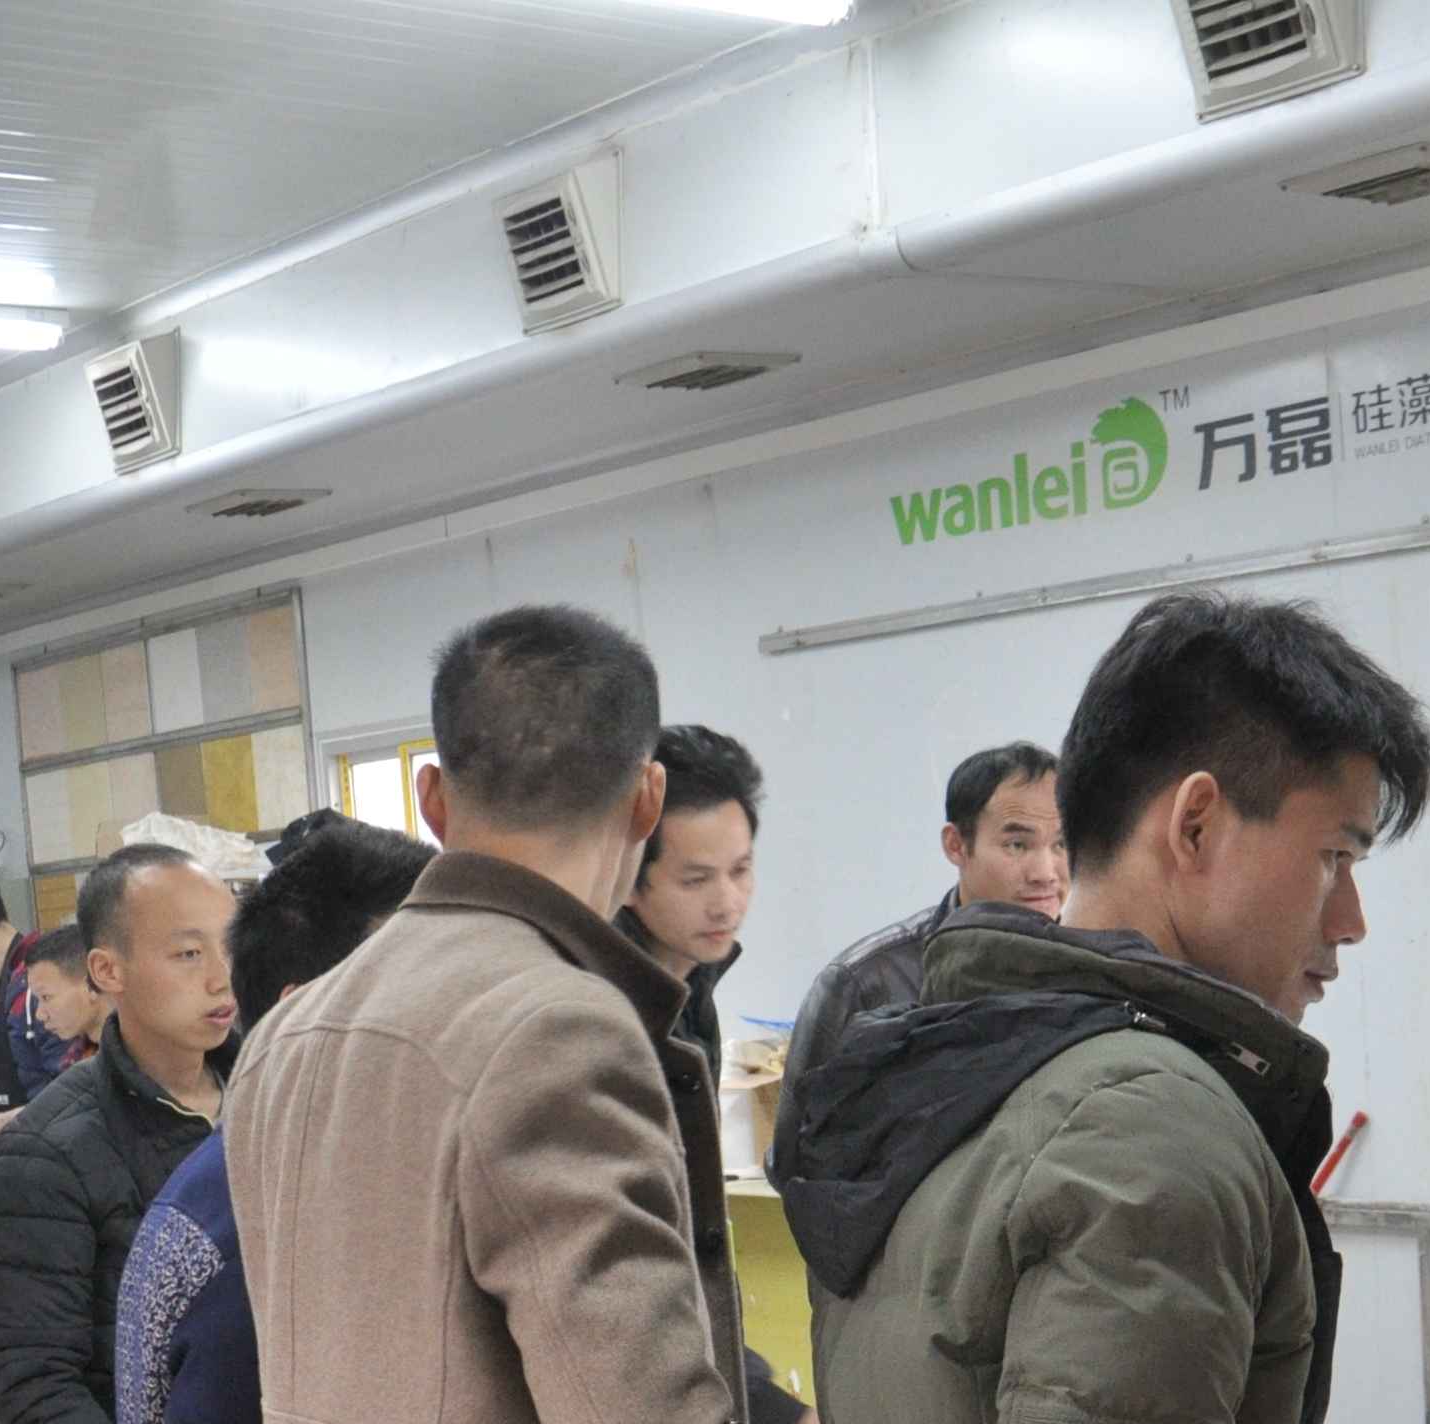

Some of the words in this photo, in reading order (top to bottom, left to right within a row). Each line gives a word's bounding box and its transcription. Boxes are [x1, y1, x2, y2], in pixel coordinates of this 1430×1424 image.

[1159, 386, 1191, 412] TM
[1194, 396, 1333, 491] 万磊
[1354, 439, 1400, 460] WANLEI
[890, 438, 1088, 545] wanlei
